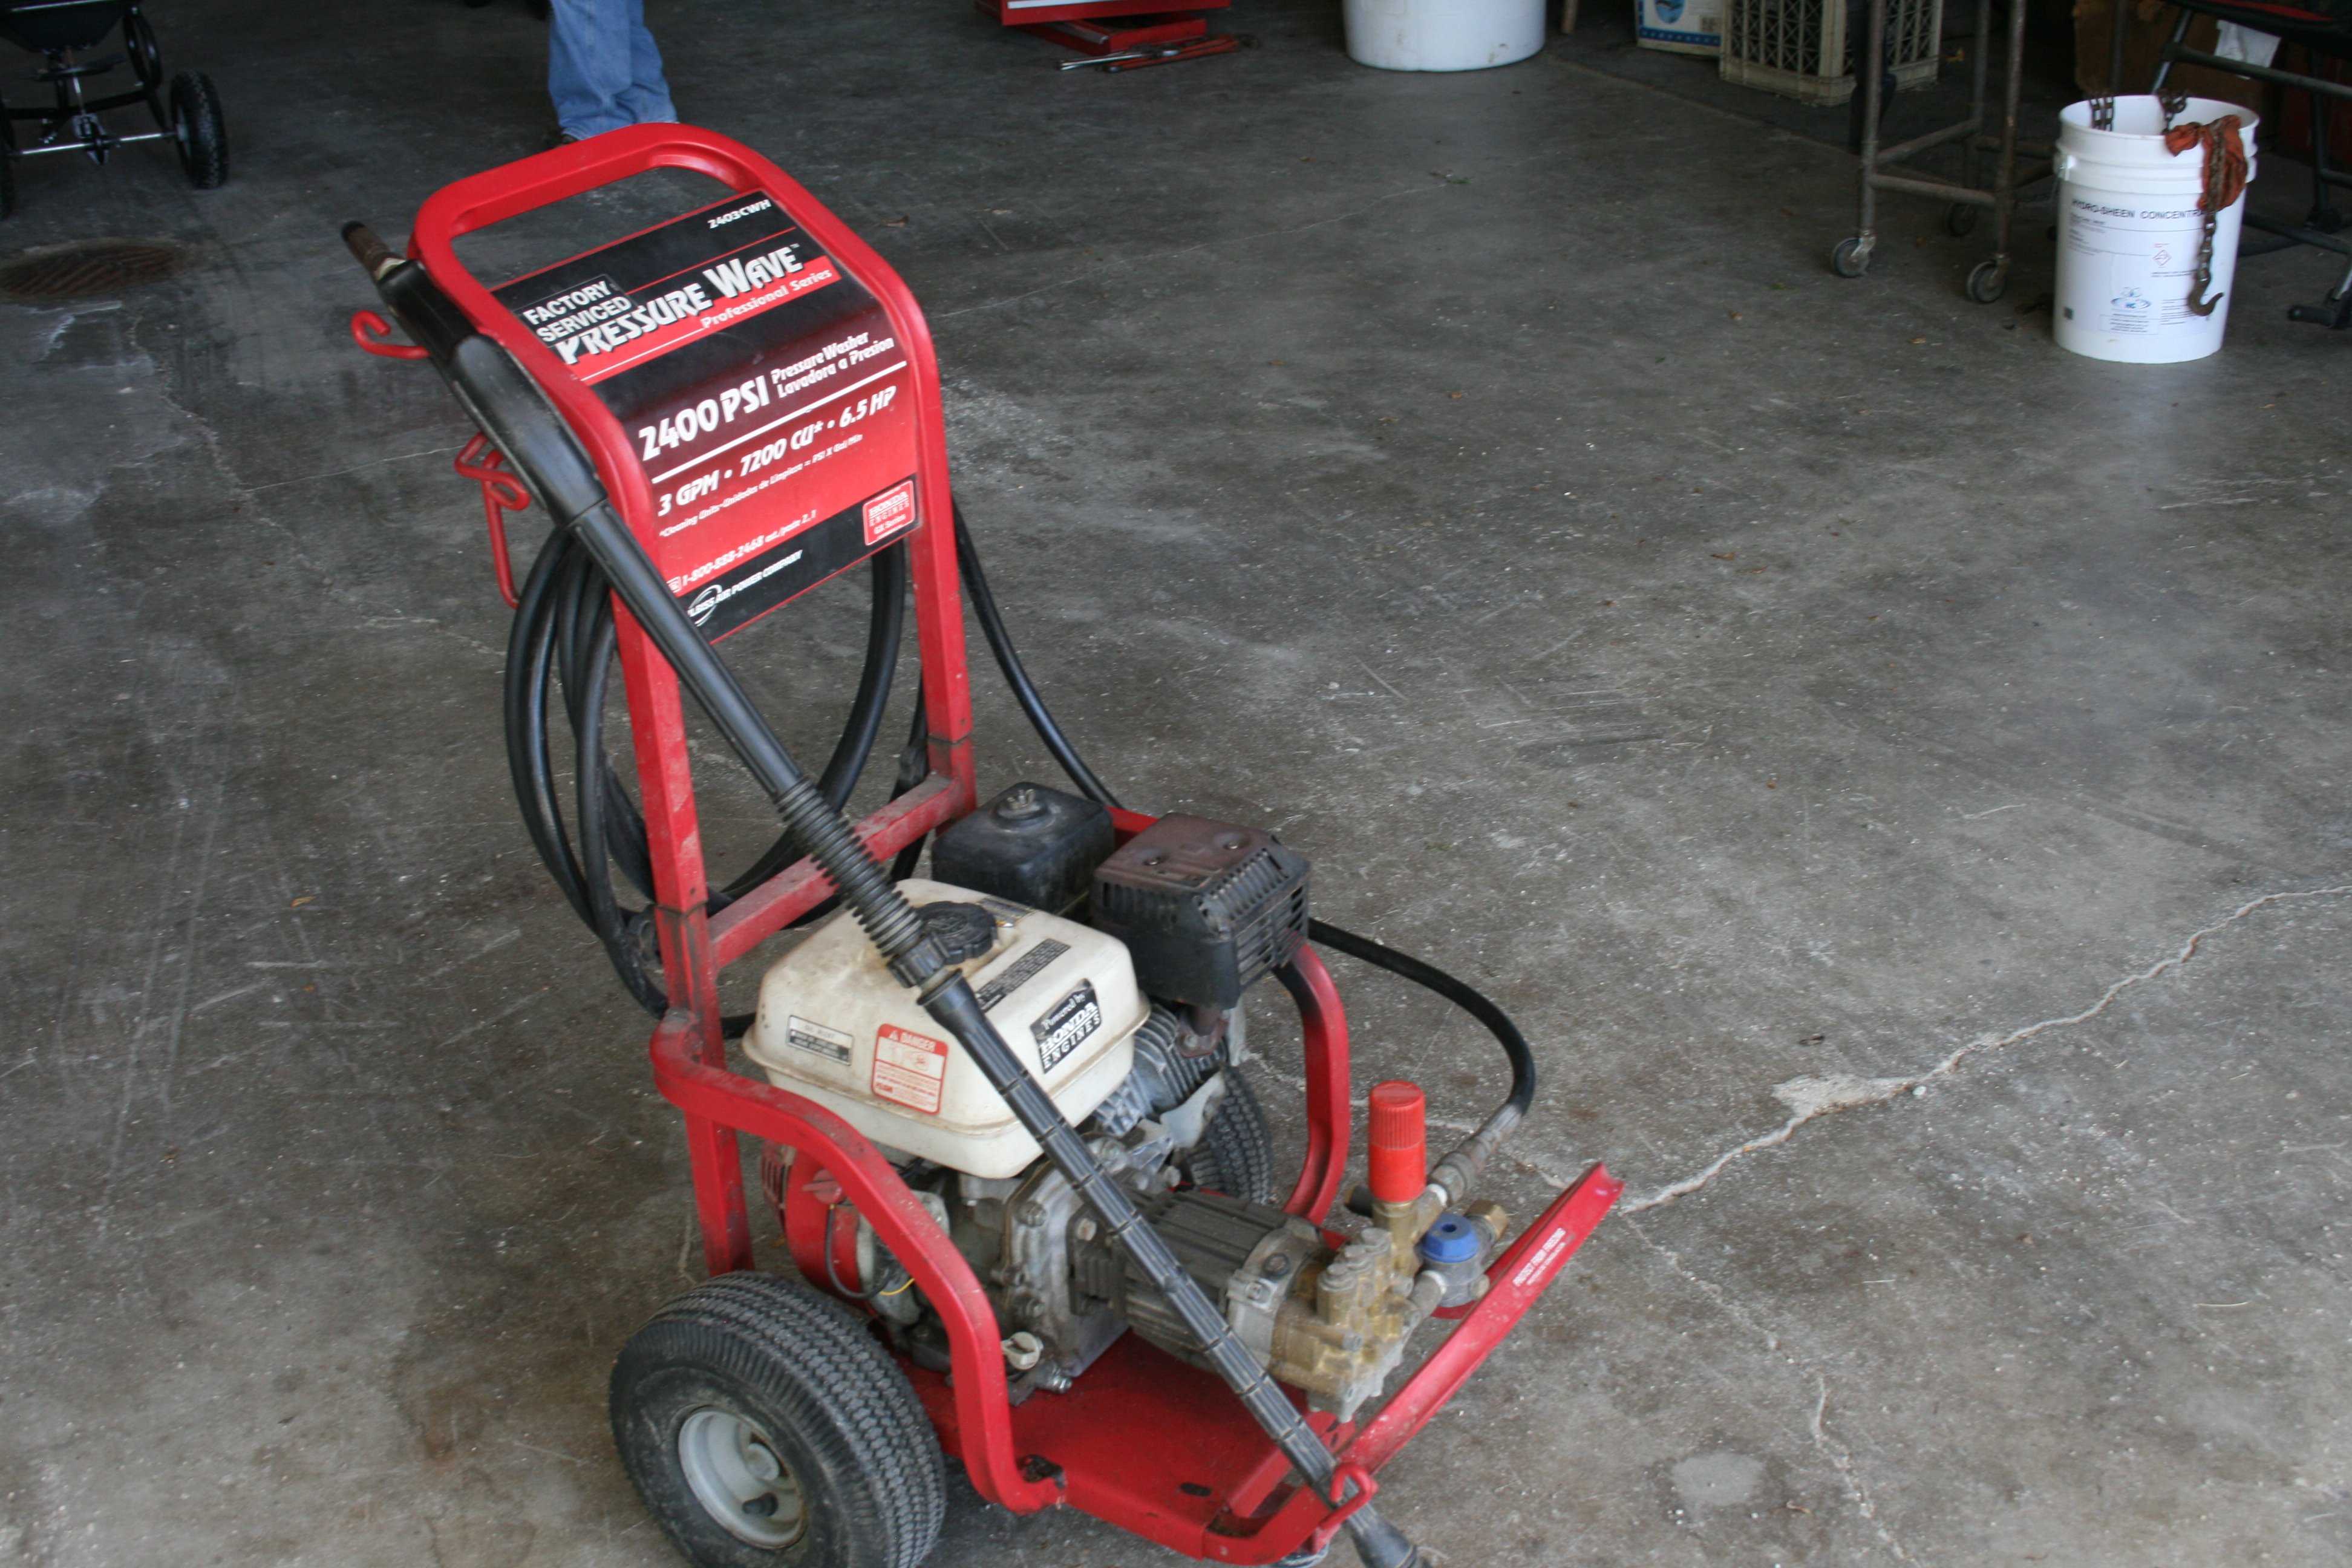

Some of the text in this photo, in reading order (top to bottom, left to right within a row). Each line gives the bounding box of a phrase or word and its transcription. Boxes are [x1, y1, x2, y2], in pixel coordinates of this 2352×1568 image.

[708, 199, 772, 229] 2403CWH
[2140, 208, 2207, 220] CONCENTRA
[523, 281, 611, 325] FACTORY
[537, 296, 632, 342] SERVICED
[555, 283, 714, 365] PRESSURE
[702, 246, 803, 298] WAVE
[700, 269, 832, 328] Professional Series
[771, 332, 869, 384] Pressure Washer
[777, 338, 894, 399] Lavadora a Presion
[638, 375, 770, 462] 2400 PSI
[658, 493, 672, 517] 3
[676, 469, 720, 506] GPM
[740, 438, 787, 477] 7200
[839, 398, 868, 428] 6.5
[869, 385, 897, 416] HP
[868, 491, 909, 517] HONDA
[869, 500, 910, 527] ENGINES
[715, 587, 732, 604] AIR
[731, 571, 763, 595] POWER
[762, 549, 803, 578] COMPANY
[1039, 1002, 1098, 1054] HONDA
[1040, 992, 1086, 1030] Powered by
[900, 1031, 936, 1053] DANGER
[1042, 1013, 1100, 1070] ENGINES
